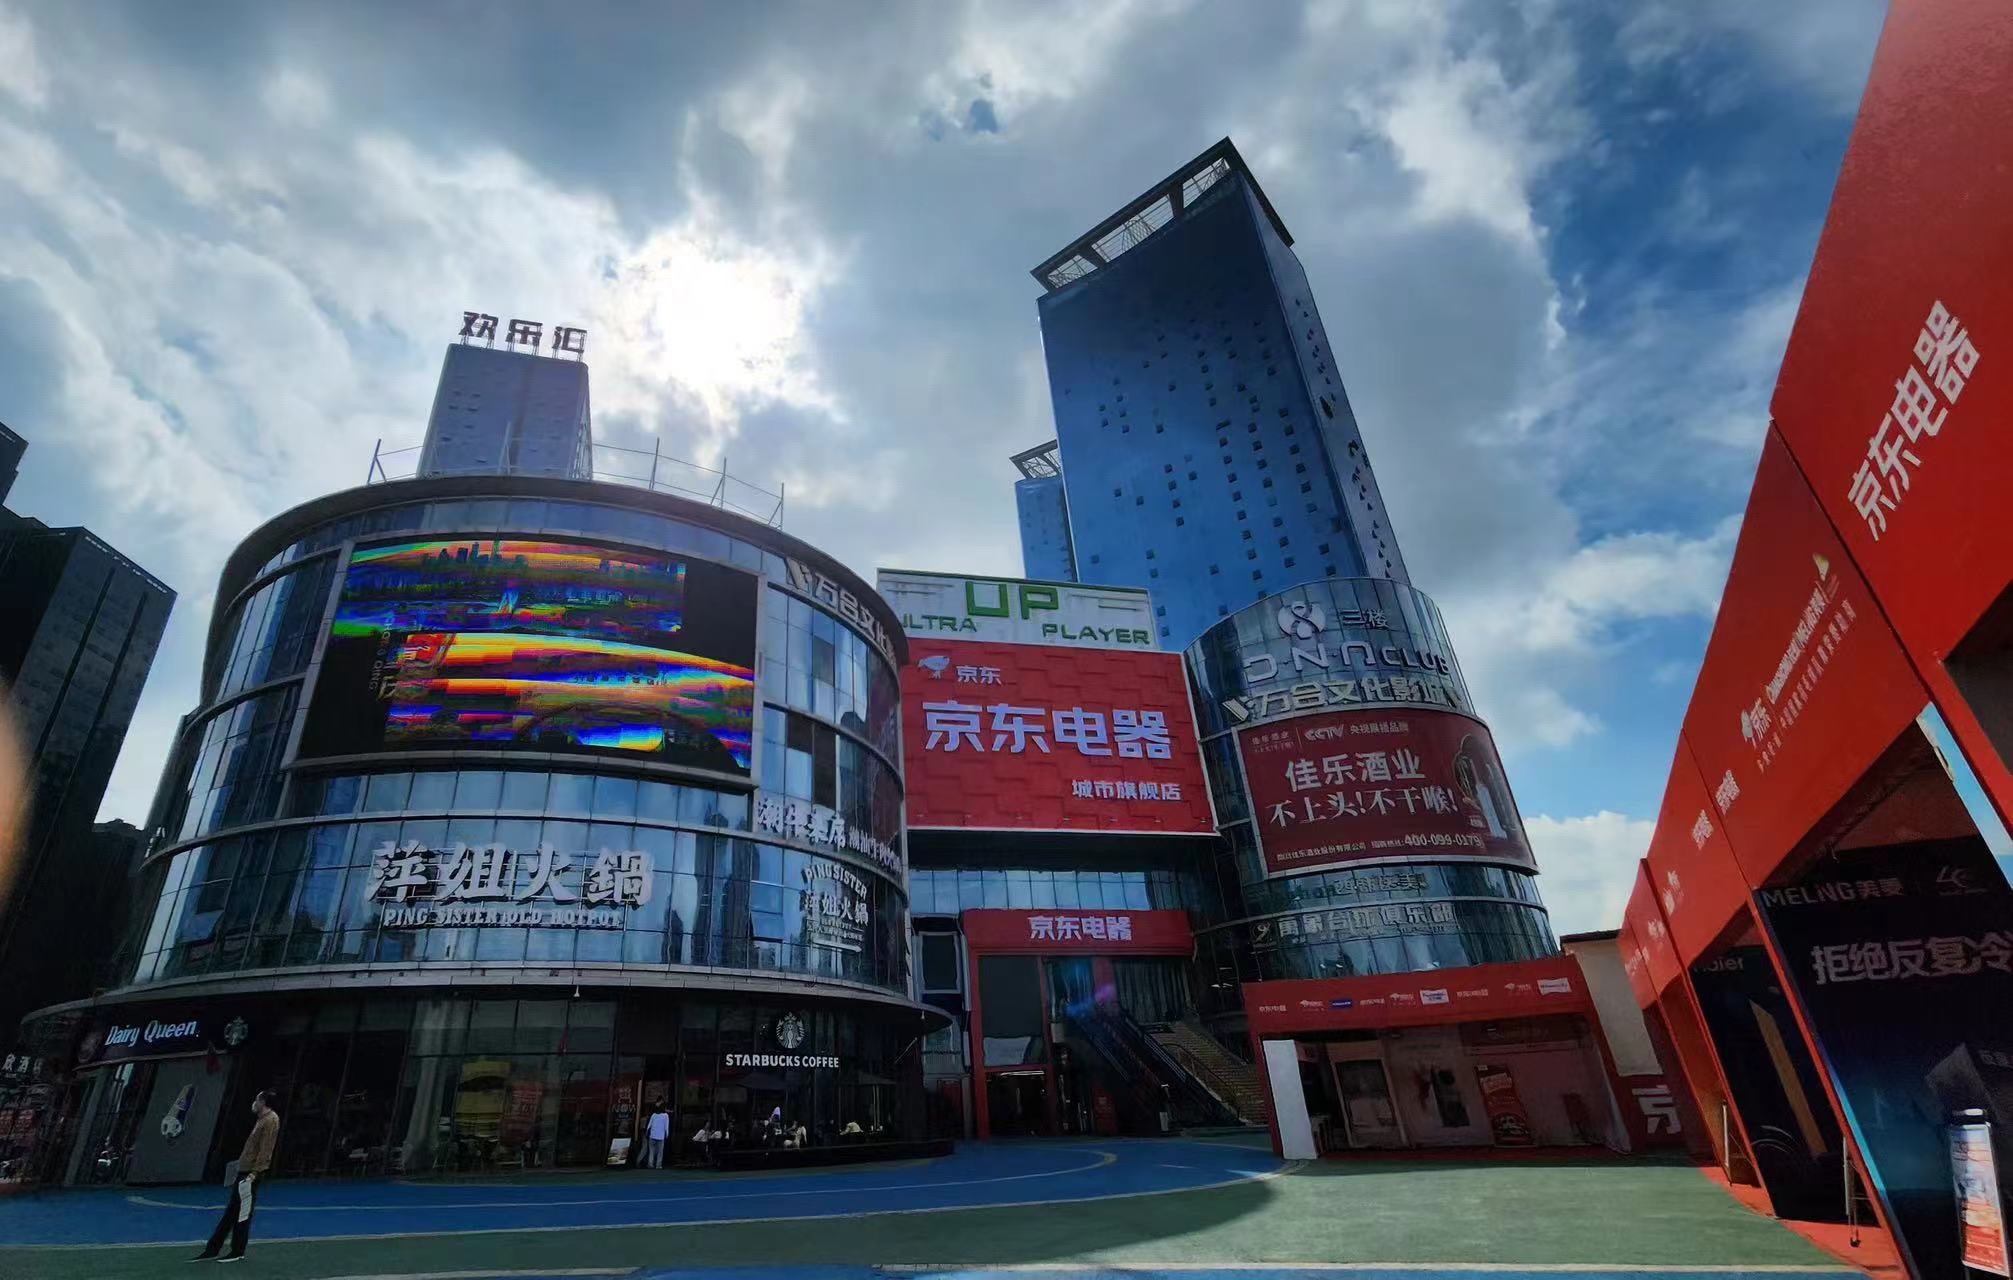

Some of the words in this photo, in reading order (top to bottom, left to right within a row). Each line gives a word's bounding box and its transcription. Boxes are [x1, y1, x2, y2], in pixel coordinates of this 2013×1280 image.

[459, 310, 588, 353] 欢乐汇
[1847, 300, 1981, 542] 京东电器
[966, 581, 1060, 620] UP
[1042, 622, 1151, 646] PLAYER
[1380, 646, 1450, 676] CLUB
[956, 665, 1002, 686] 京东
[922, 699, 1172, 761] 京东电器
[1284, 747, 1427, 792] 佳乐酒业
[1071, 779, 1183, 802] 城市旗舰店
[383, 907, 429, 927] PING
[1028, 915, 1132, 942] 京东电器
[105, 1023, 140, 1047] Dairy
[144, 1019, 198, 1043] Queen
[725, 1053, 800, 1068] STARBUCKS
[801, 1054, 840, 1069] COFFEE
